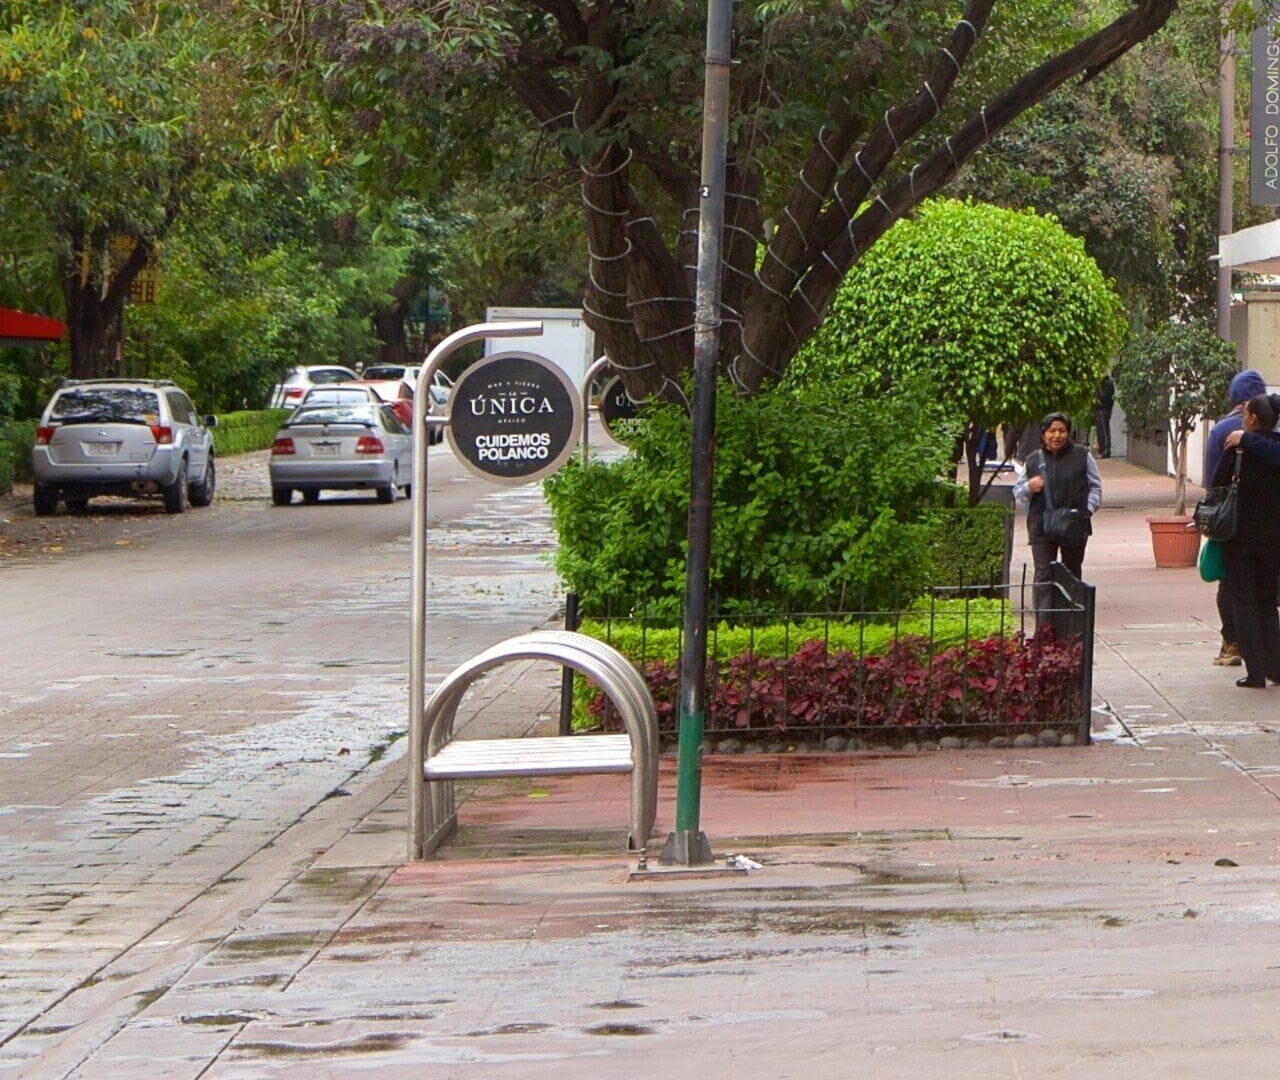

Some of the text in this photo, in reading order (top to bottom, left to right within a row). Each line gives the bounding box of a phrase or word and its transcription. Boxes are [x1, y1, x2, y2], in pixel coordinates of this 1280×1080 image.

[1265, 124, 1279, 191] ADOLFO
[468, 394, 554, 416] ÚNICA
[475, 433, 551, 448] CUIDEMOS
[478, 446, 549, 461] POLANCO
